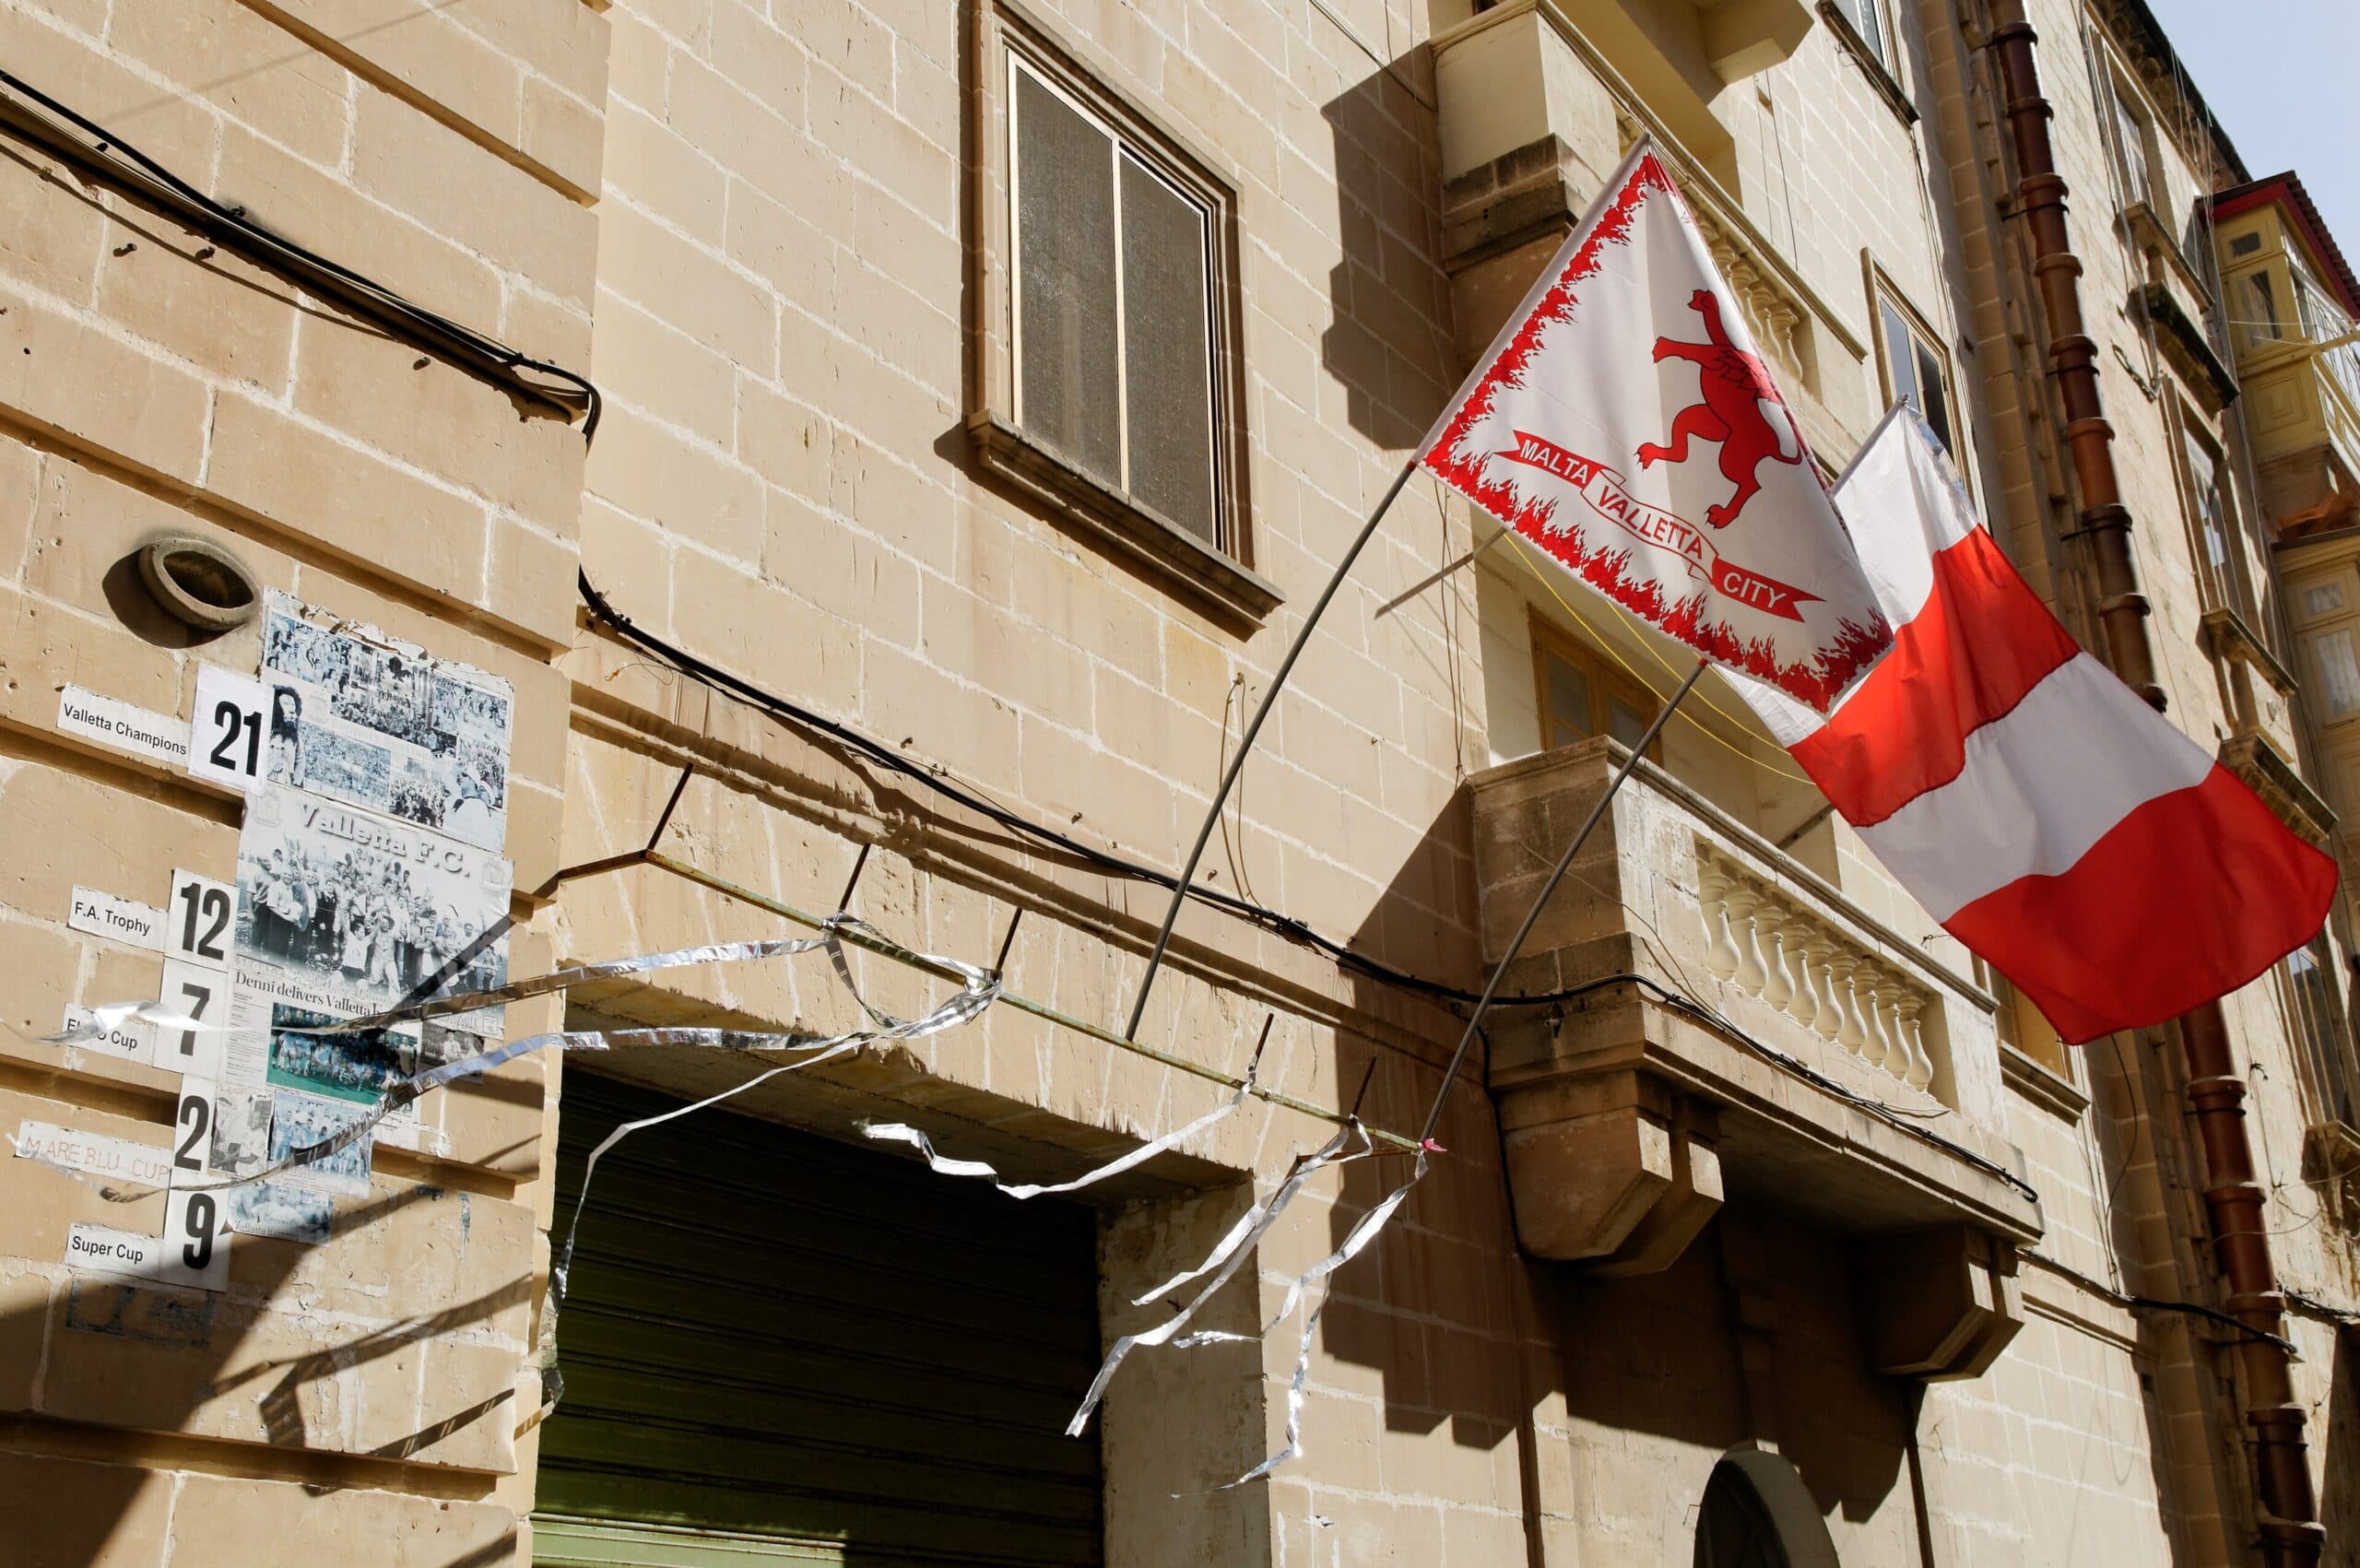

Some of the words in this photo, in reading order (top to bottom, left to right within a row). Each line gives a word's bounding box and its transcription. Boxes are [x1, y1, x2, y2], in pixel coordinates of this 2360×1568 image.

[1519, 439, 1589, 485] MALTA
[1599, 485, 1703, 560] VALLETTA
[1722, 571, 1788, 609] CITY
[63, 702, 112, 731] Valletta
[115, 722, 187, 755] Champions
[209, 701, 263, 777] 21
[302, 803, 407, 857] Valletta
[416, 842, 470, 877] F.C.
[75, 902, 100, 921] F.A.
[105, 910, 150, 937] Trophy
[181, 882, 230, 961] 12
[180, 982, 211, 1056] 7
[235, 972, 275, 993] Denni
[277, 983, 324, 1006] delivers
[325, 995, 371, 1017] Valletta
[111, 1031, 138, 1051] Cup
[84, 1147, 120, 1171] BLU
[132, 1159, 170, 1181] CUP
[174, 1095, 209, 1172] 2
[72, 1235, 112, 1256] Super
[116, 1244, 144, 1265] Cup
[183, 1193, 216, 1270] 9
